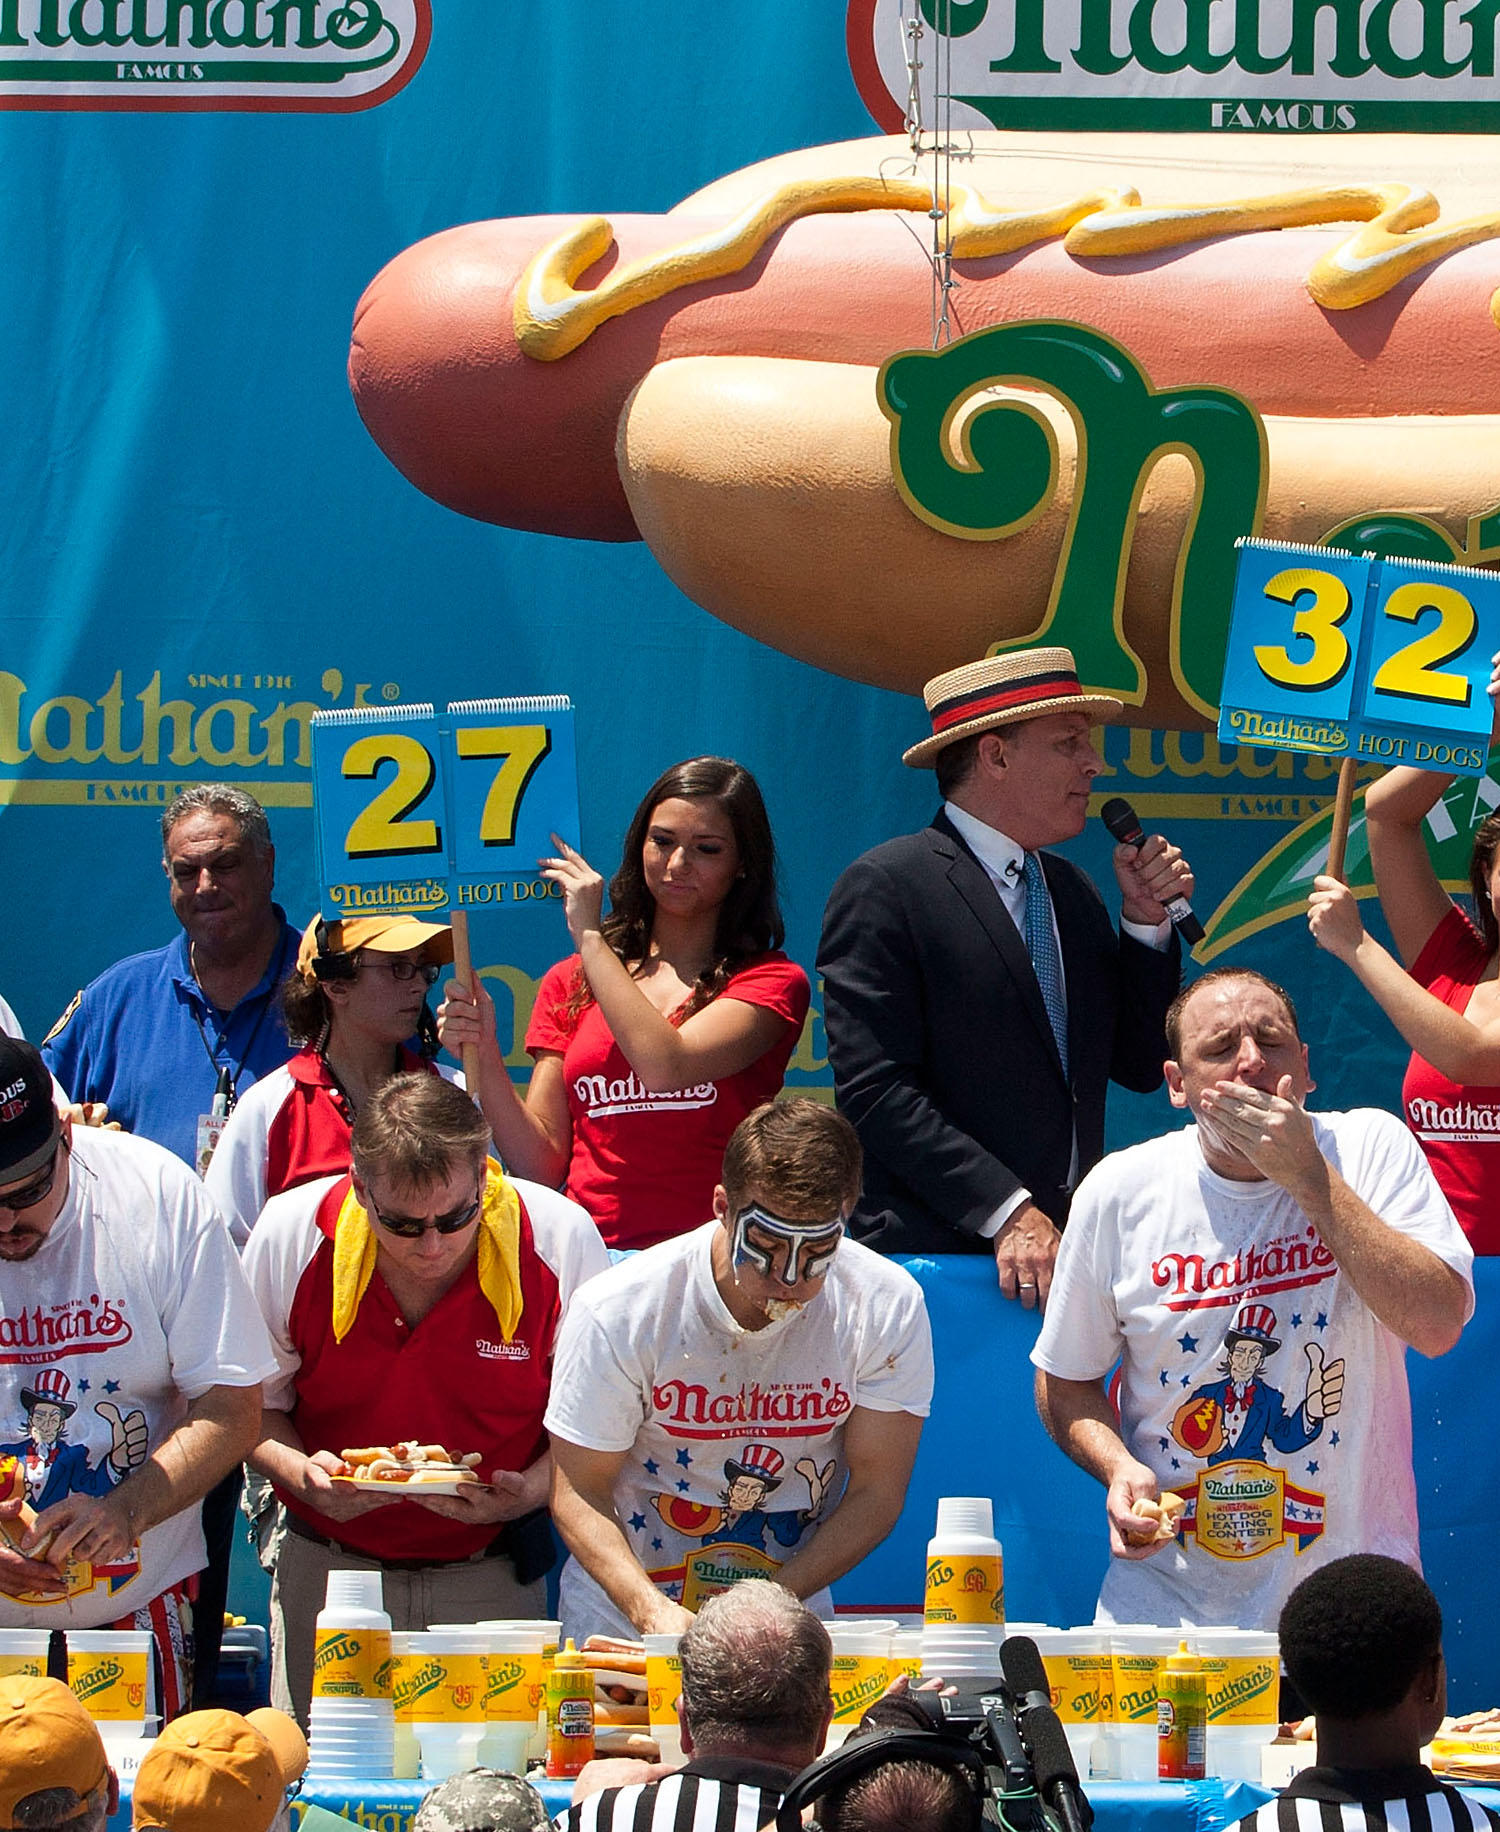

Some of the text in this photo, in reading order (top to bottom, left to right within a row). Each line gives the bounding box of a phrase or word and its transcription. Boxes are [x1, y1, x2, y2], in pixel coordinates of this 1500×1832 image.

[117, 64, 204, 80] FAMOUS
[1210, 103, 1357, 130] FAMOUS
[1253, 567, 1477, 706] 32
[187, 674, 297, 689] SINCE 1916
[1230, 709, 1347, 746] Nathan's
[1358, 733, 1410, 758] HOT
[1415, 742, 1484, 769] DOGS
[341, 724, 553, 859] 27
[329, 879, 566, 908] Nathan's HOT DOG
[1151, 1225, 1336, 1295] Nathan's
[0, 1293, 123, 1348] athan's
[475, 1339, 531, 1356] Nathan's
[652, 1377, 852, 1425] Nathan's
[1205, 1479, 1276, 1496] Nathan's
[1206, 1509, 1273, 1521] HOT DOG
[1212, 1518, 1267, 1530] EATING
[1206, 1527, 1274, 1538] CONTEST
[455, 1684, 472, 1704] 95
